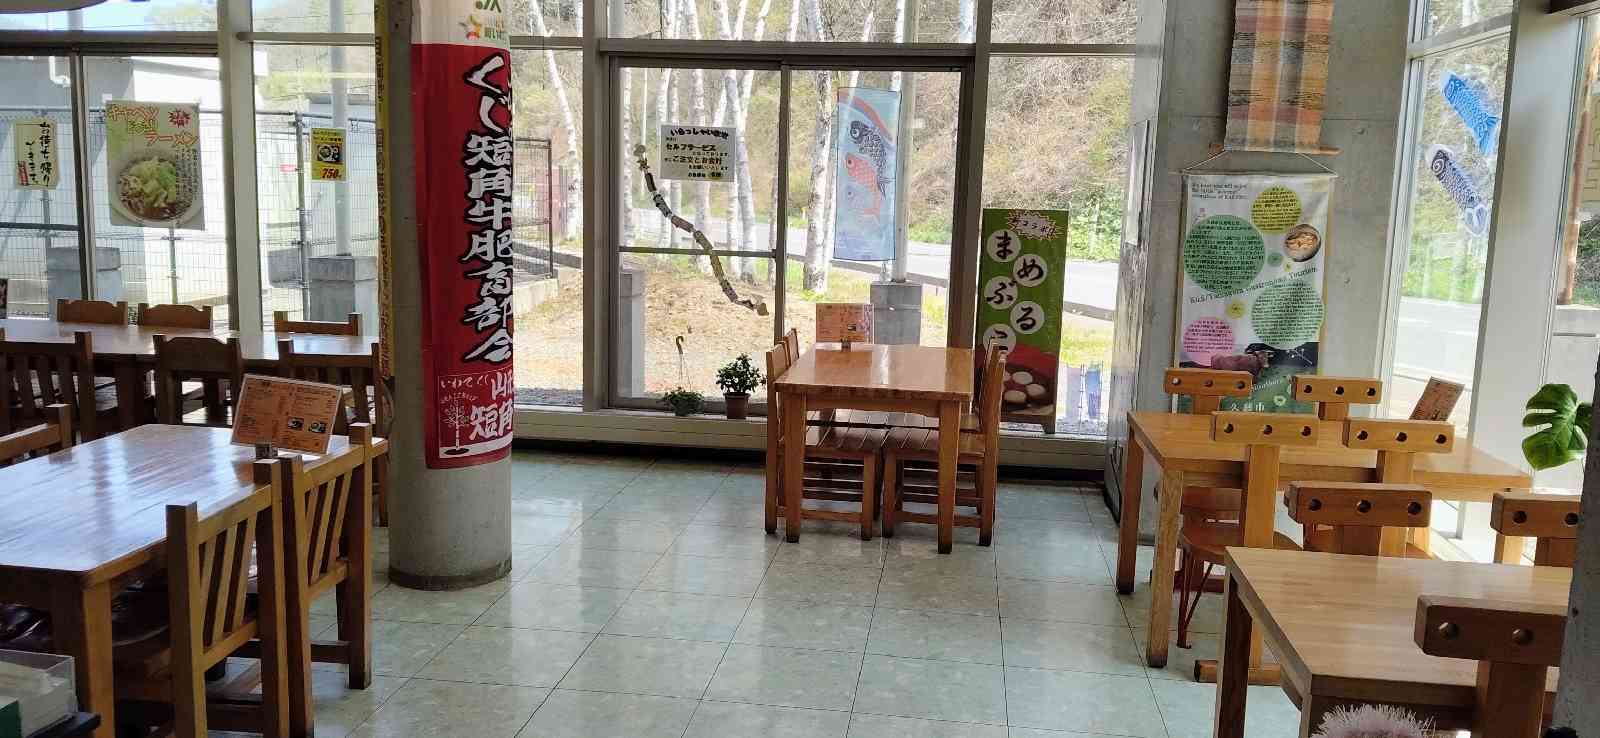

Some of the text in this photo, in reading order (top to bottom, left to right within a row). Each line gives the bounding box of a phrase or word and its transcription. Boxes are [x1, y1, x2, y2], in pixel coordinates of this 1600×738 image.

[144, 132, 200, 146] ラーメン
[665, 143, 717, 152] セルフサービス
[463, 53, 512, 364] くじ短角牛肥育部会
